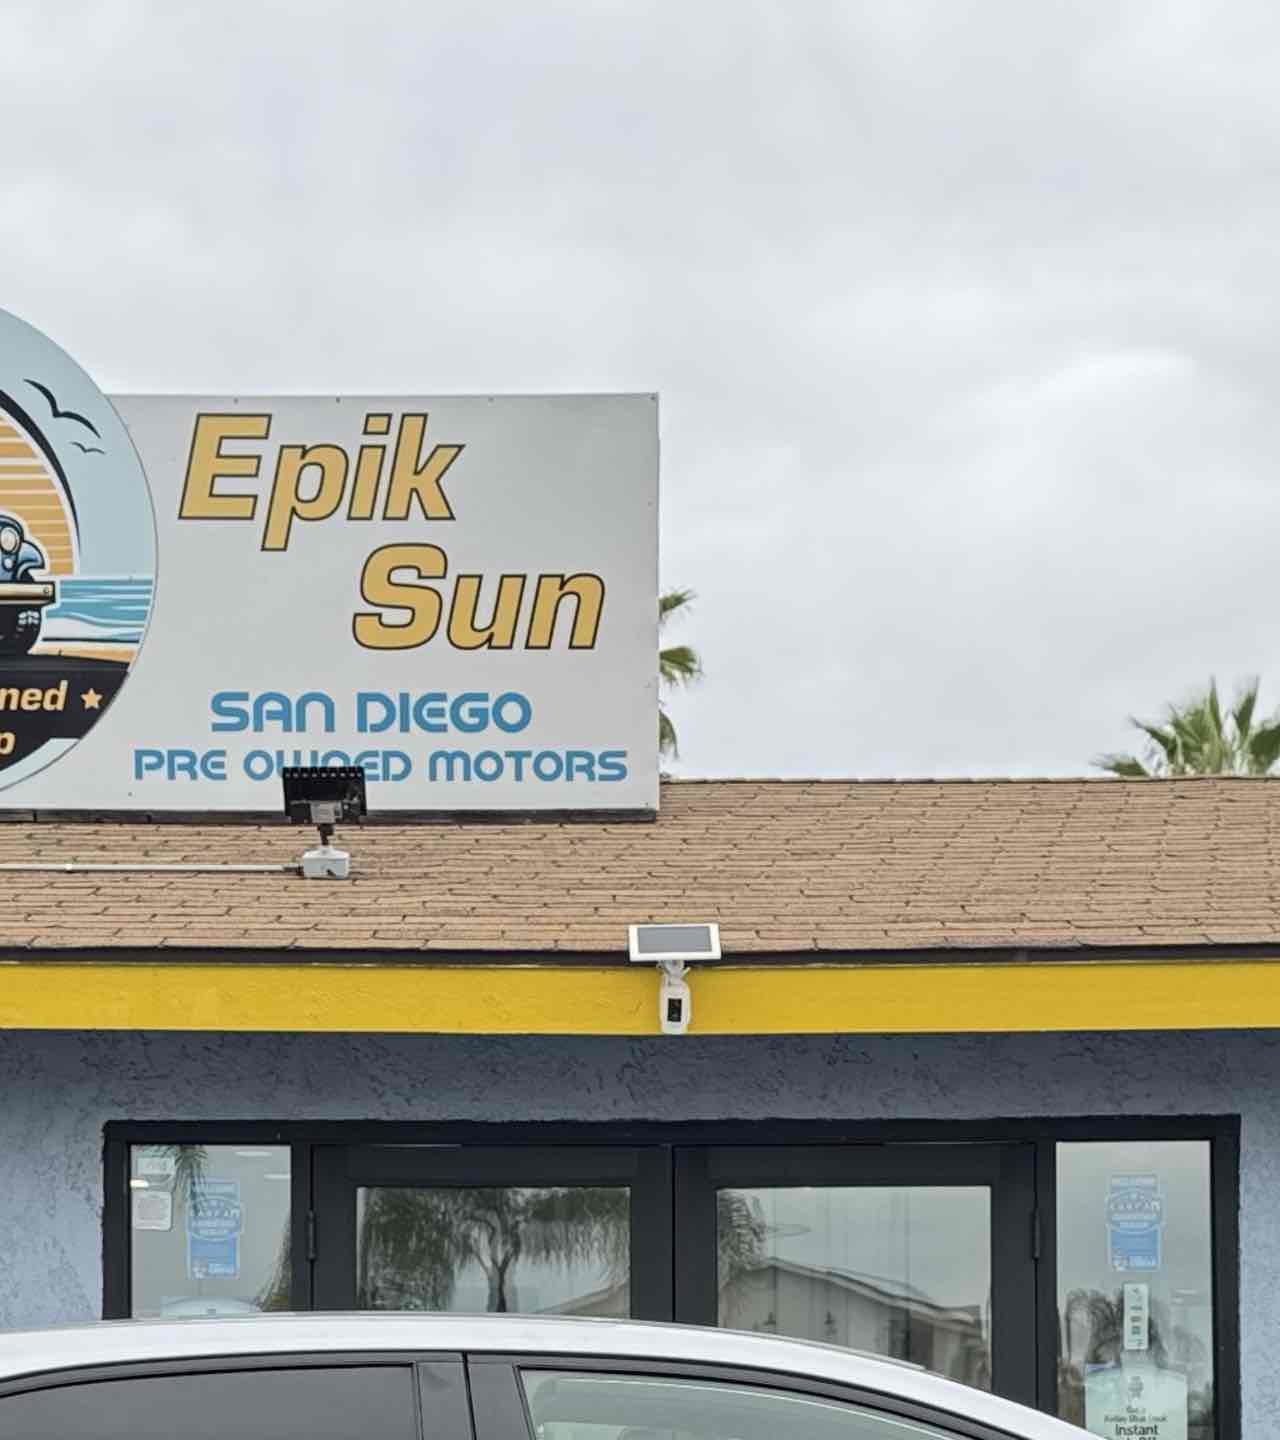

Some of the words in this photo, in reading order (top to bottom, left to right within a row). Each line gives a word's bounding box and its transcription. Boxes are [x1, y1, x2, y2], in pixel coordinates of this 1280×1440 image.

[177, 412, 466, 552] Epik
[352, 541, 606, 650] Sun
[210, 691, 336, 734] SAN
[356, 691, 533, 734] DIEGO
[134, 748, 228, 782] PRE
[428, 749, 628, 782] MOTORS
[1115, 1423, 1159, 1436] Instant
